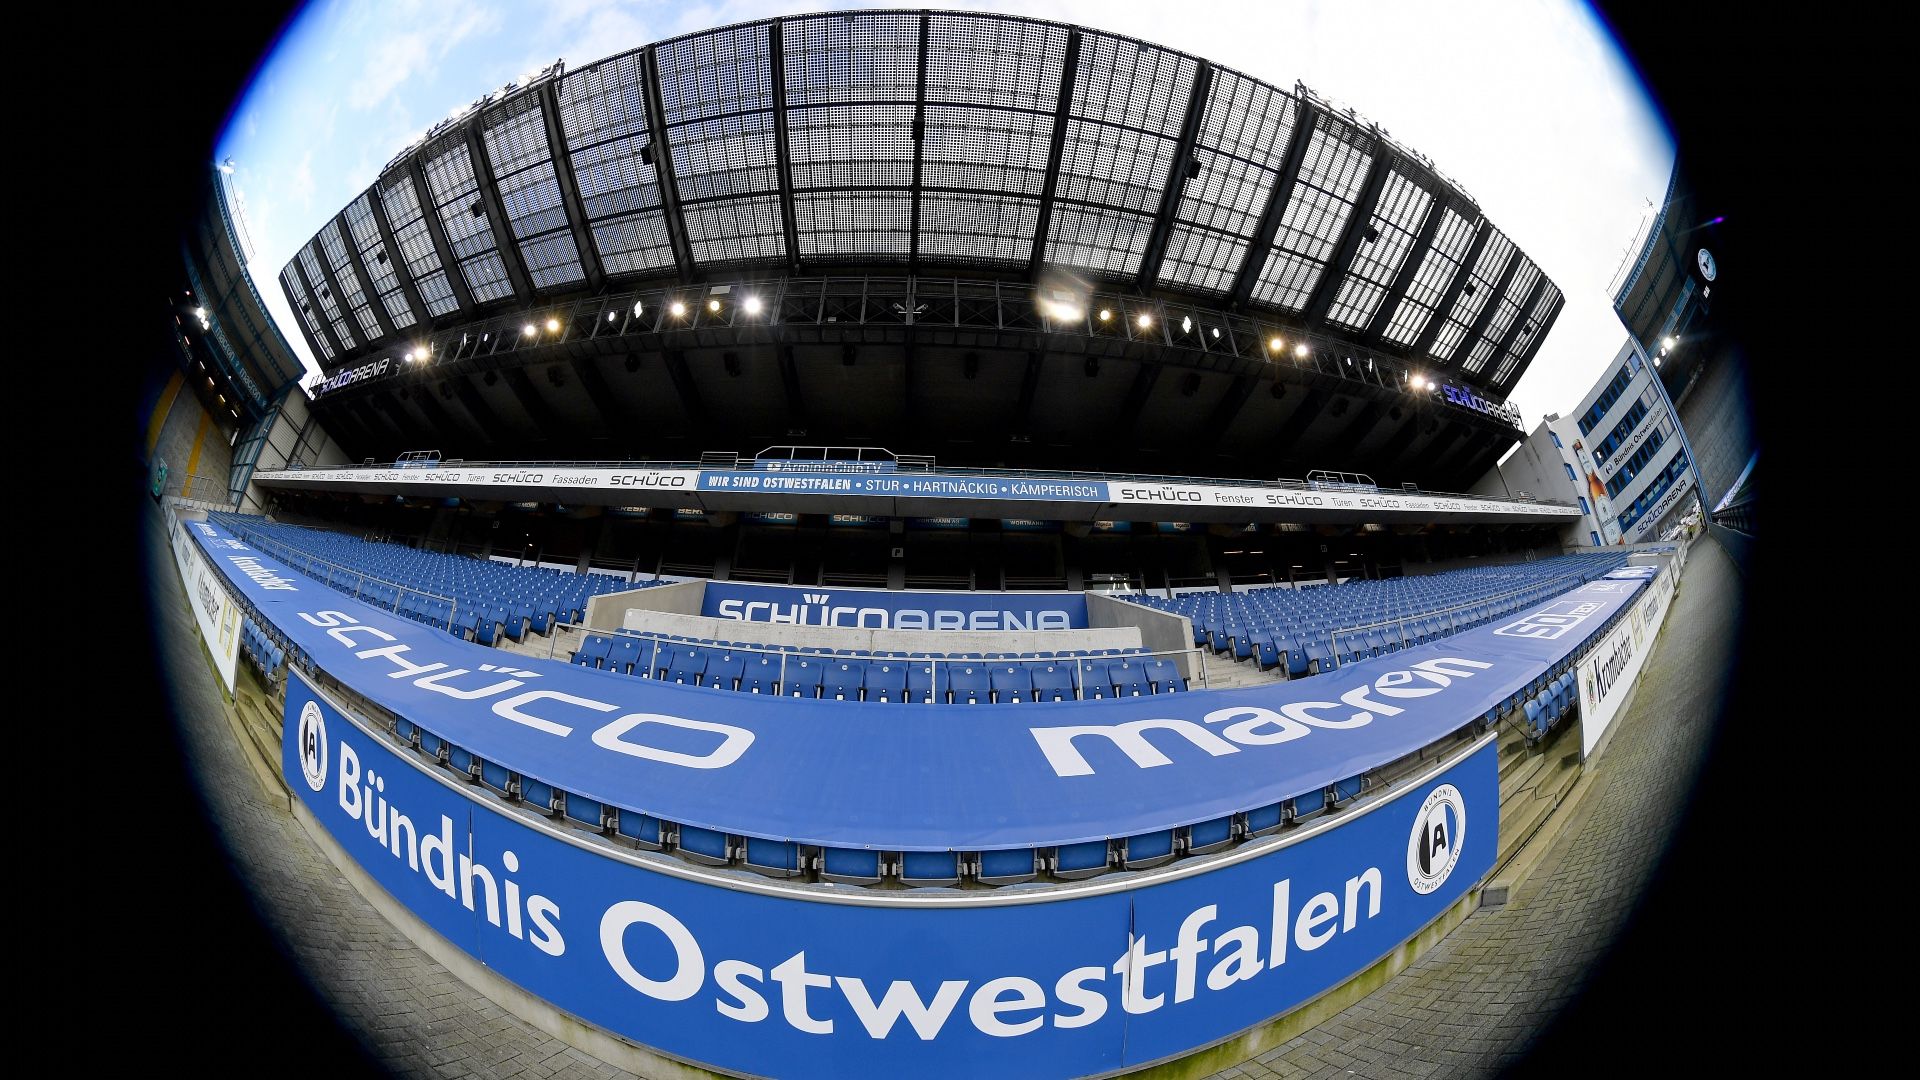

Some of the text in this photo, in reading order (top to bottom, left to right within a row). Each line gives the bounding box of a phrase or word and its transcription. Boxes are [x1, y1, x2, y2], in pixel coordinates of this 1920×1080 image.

[373, 470, 399, 481] SCHÜCO
[424, 470, 460, 483] SCHÜCO
[492, 470, 544, 483] SCHÜCO
[551, 474, 598, 485] Fassaden
[609, 472, 686, 487] SCHÜCO
[708, 476, 1098, 497] WIR SIND OSTWESTFALEN STUR HARTNÄCKIG KÄMPFERISCH
[1121, 486, 1202, 502] SCHÜCO
[1214, 492, 1254, 504] Fenster
[1266, 492, 1323, 506] SCHÜCO
[1359, 496, 1400, 509] SCHÜCO
[1434, 500, 1461, 511] SCHÜCO
[1637, 479, 1687, 534] SCHÜCOARENA
[718, 593, 1071, 631] SCHÜCOARENA
[297, 610, 756, 769] SCHÜCO
[1594, 630, 1633, 704] Krombacher
[1029, 657, 1494, 777] macron
[1431, 822, 1447, 859] A
[339, 740, 1383, 1041] Bündnis Ostwestfalen
